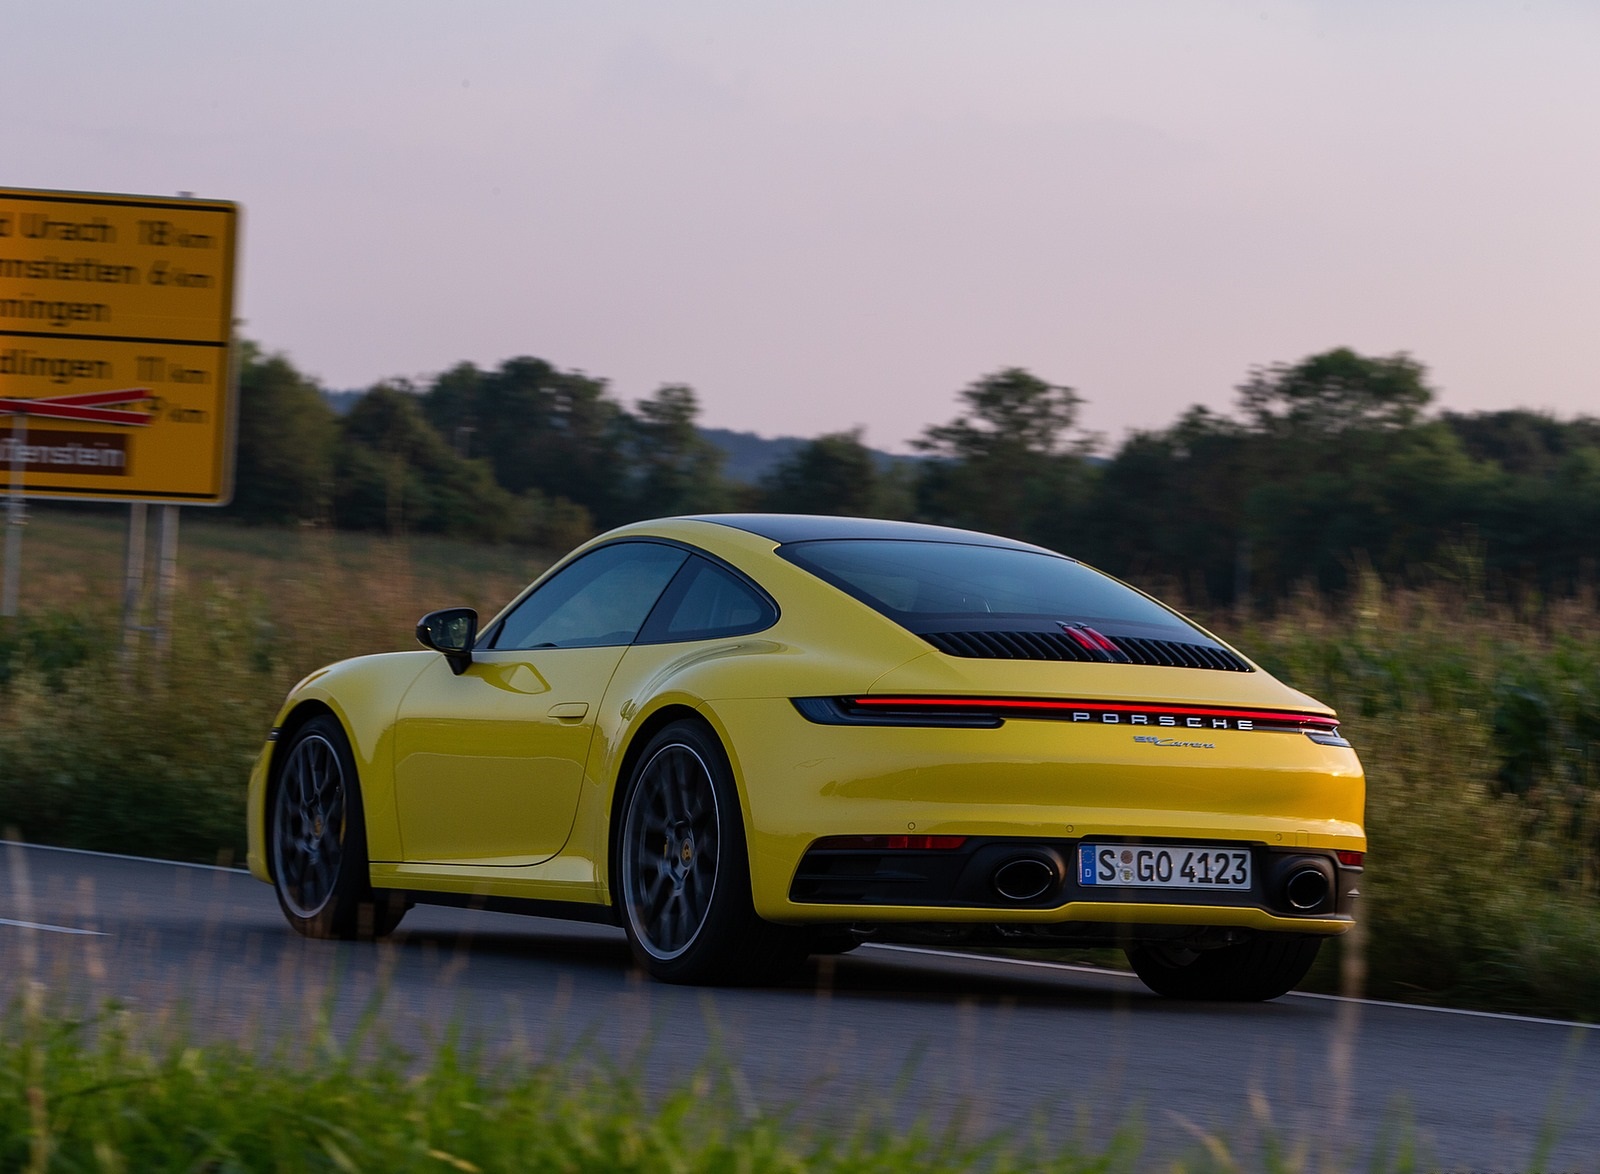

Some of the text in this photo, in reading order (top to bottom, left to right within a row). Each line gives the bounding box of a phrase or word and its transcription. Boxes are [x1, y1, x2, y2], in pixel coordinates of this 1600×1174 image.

[20, 213, 117, 243] Urach
[137, 220, 173, 246] 18
[1073, 712, 1253, 730] PORSCHE
[1154, 738, 1215, 749] Carrera
[1084, 868, 1092, 878] D
[1098, 849, 1248, 885] S GO 4123
